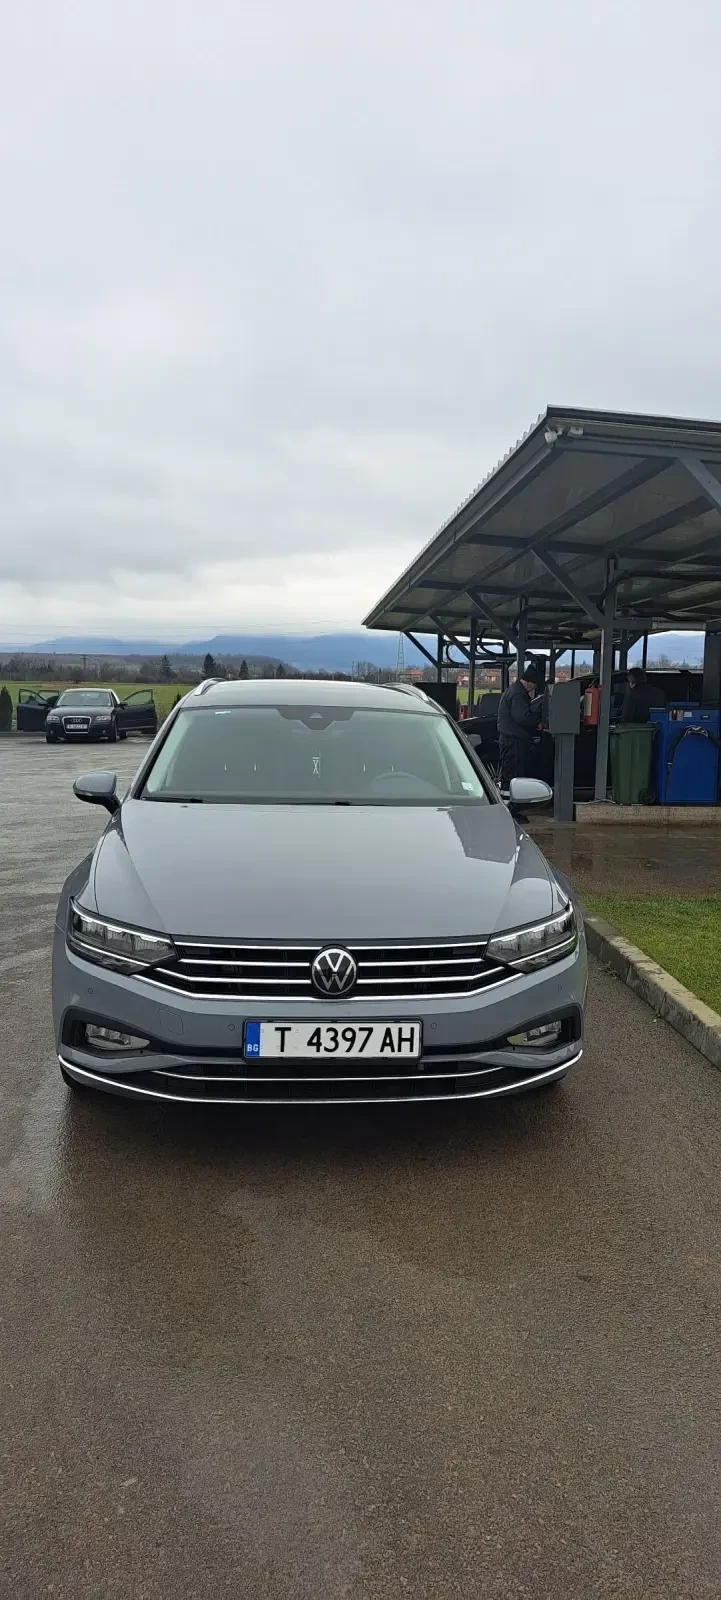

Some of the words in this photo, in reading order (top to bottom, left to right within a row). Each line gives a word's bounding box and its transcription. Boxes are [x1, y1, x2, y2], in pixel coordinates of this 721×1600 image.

[313, 949, 356, 994] VW
[247, 1044, 259, 1052] BG
[275, 1027, 292, 1053] T
[307, 1027, 374, 1053] 4397
[379, 1027, 415, 1053] AH
